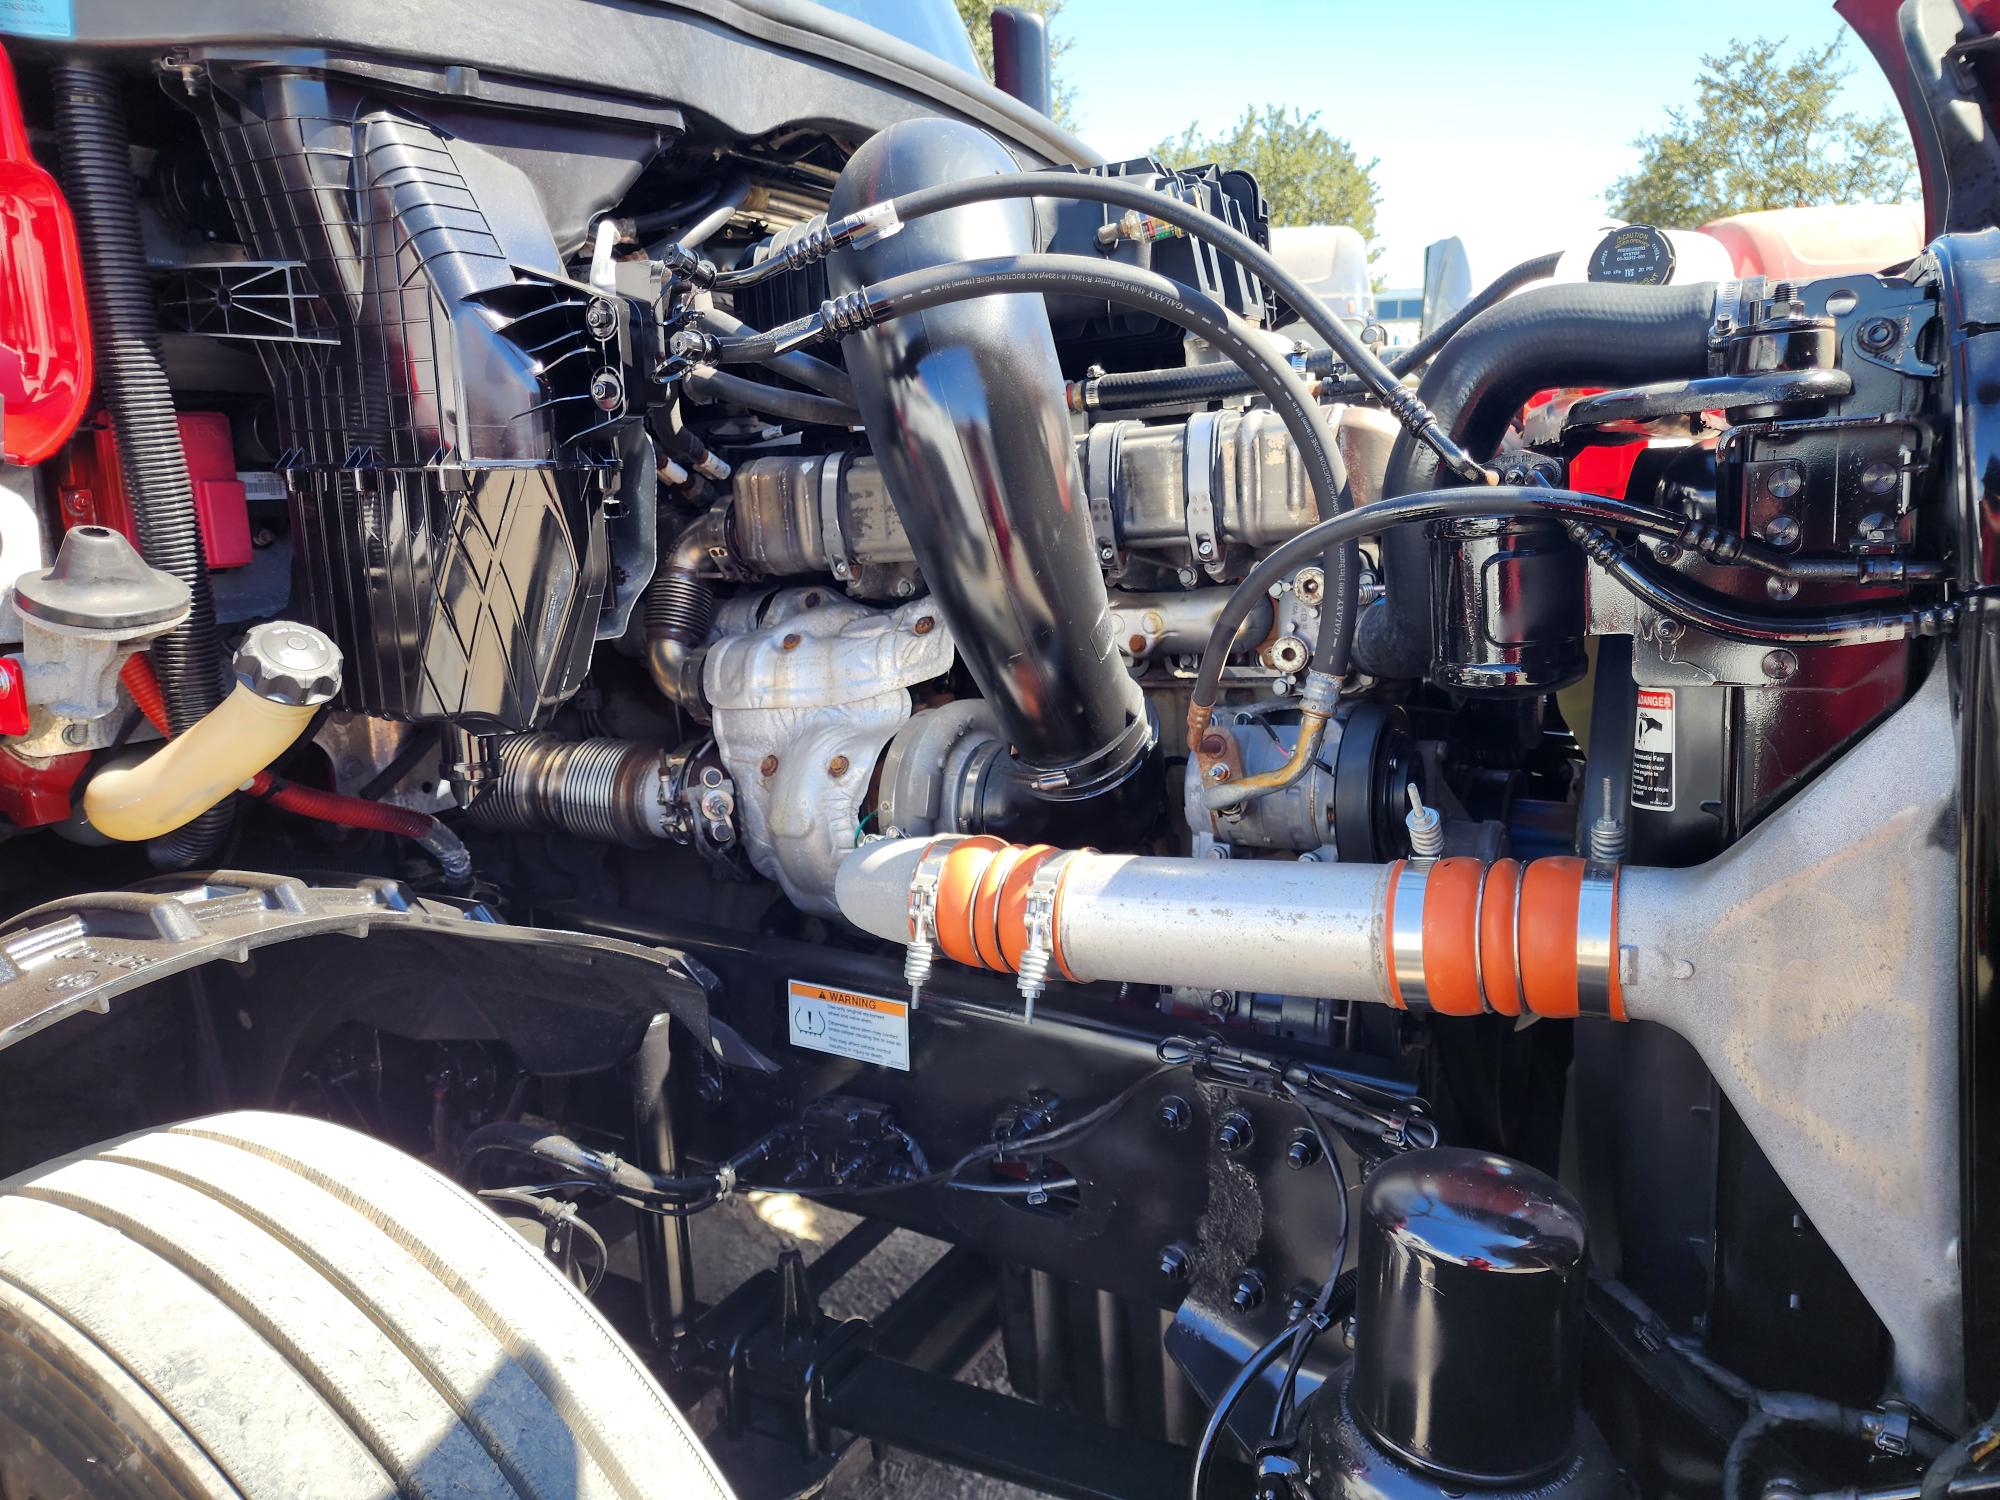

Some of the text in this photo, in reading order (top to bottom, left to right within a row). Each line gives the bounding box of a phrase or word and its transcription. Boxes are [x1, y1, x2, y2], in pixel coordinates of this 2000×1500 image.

[1622, 231, 1649, 240] CAUTION
[952, 278, 975, 288] (19mm)
[976, 274, 996, 284] HOSE
[996, 272, 1026, 282] SUCTION
[1072, 274, 1094, 284] R-134a
[1095, 276, 1130, 291] FlexBarrier
[1145, 291, 1184, 310] GALAXY
[1300, 416, 1316, 438] (19mm)
[1310, 437, 1322, 456] HOSE
[1320, 455, 1332, 484] SUCTION
[1334, 599, 1344, 635] GALAXY
[1640, 694, 1671, 708] DANGER
[830, 992, 876, 1010] WARNING
